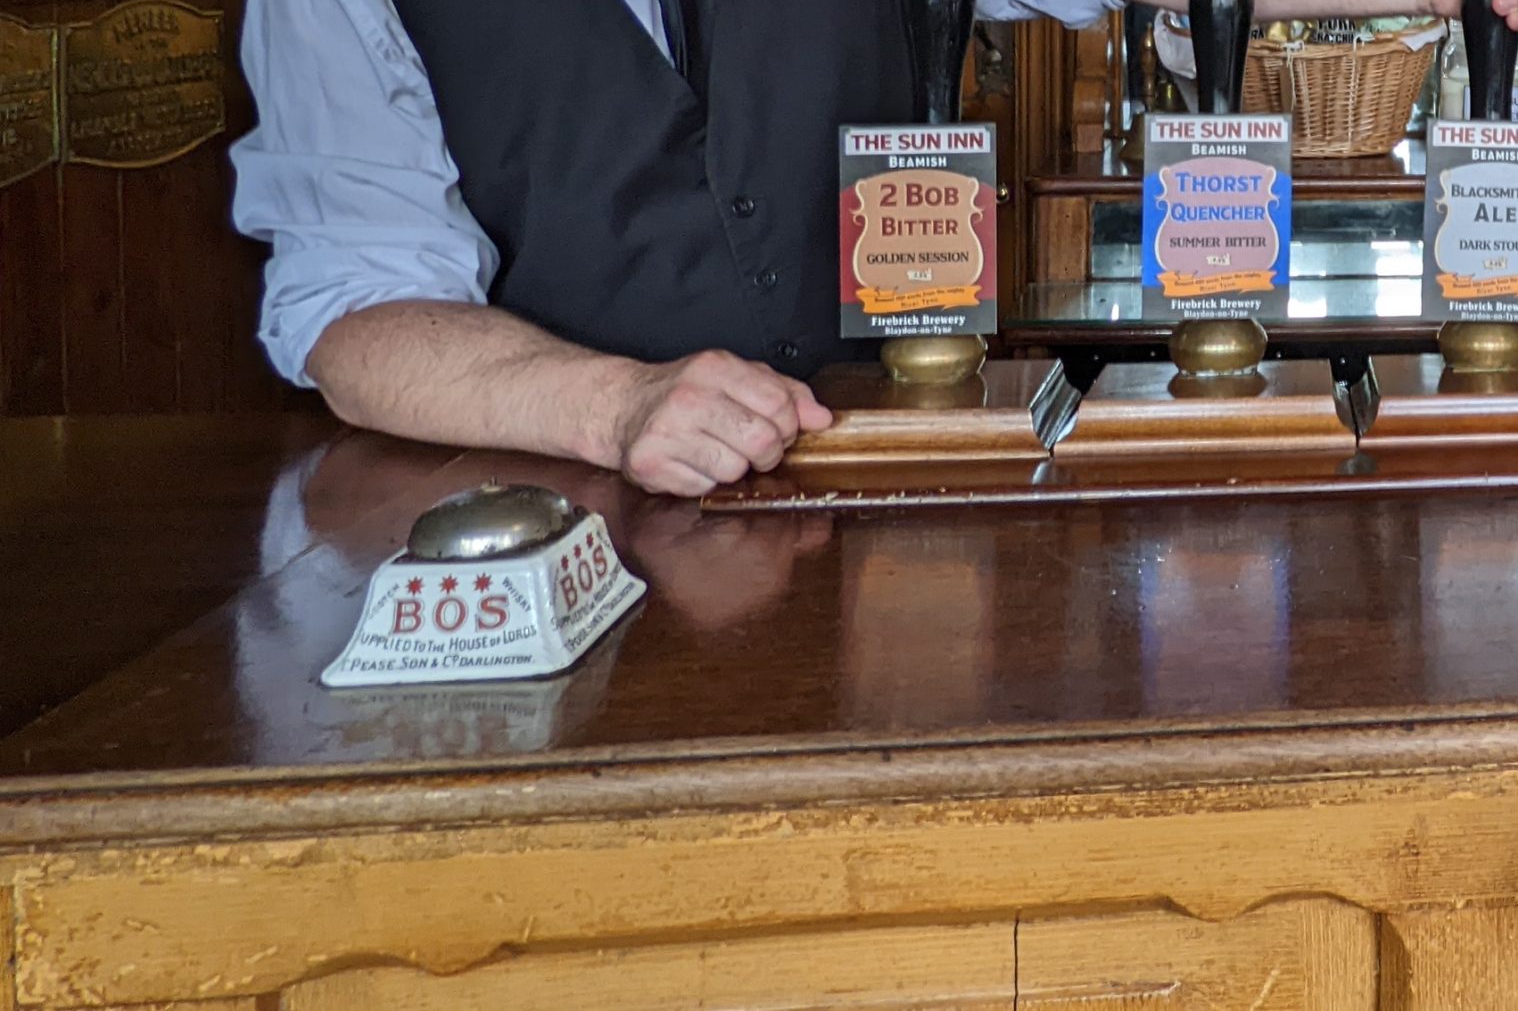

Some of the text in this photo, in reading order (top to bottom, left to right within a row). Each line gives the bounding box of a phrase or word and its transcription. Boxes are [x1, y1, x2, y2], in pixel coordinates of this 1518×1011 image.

[1156, 122, 1282, 138] THE SUN INN
[1438, 126, 1476, 144] THE
[851, 132, 984, 151] THE SUN INN
[1191, 144, 1247, 156] BEAMISH
[888, 155, 947, 169] BEAMISH
[1175, 172, 1263, 193] THORST
[879, 182, 960, 207] 2 BOB
[1170, 203, 1266, 222] QUENCHER
[1473, 202, 1518, 223] ALE
[881, 216, 960, 238] BITTER
[1169, 236, 1267, 248] SUMMER BITTER
[1459, 239, 1492, 251] DARK
[866, 251, 970, 265] GOLDEN SESSION
[1171, 298, 1262, 310] Firebrick Brewery
[1449, 301, 1494, 312] Firebrick
[871, 314, 966, 327] Firebrick Brewery
[560, 545, 608, 611] BOS
[502, 575, 533, 613] WHISKY
[389, 594, 511, 635] BOS
[449, 636, 488, 652] HOUSE
[502, 625, 538, 644] LORDS
[401, 656, 429, 669] SON
[430, 658, 439, 668] &
